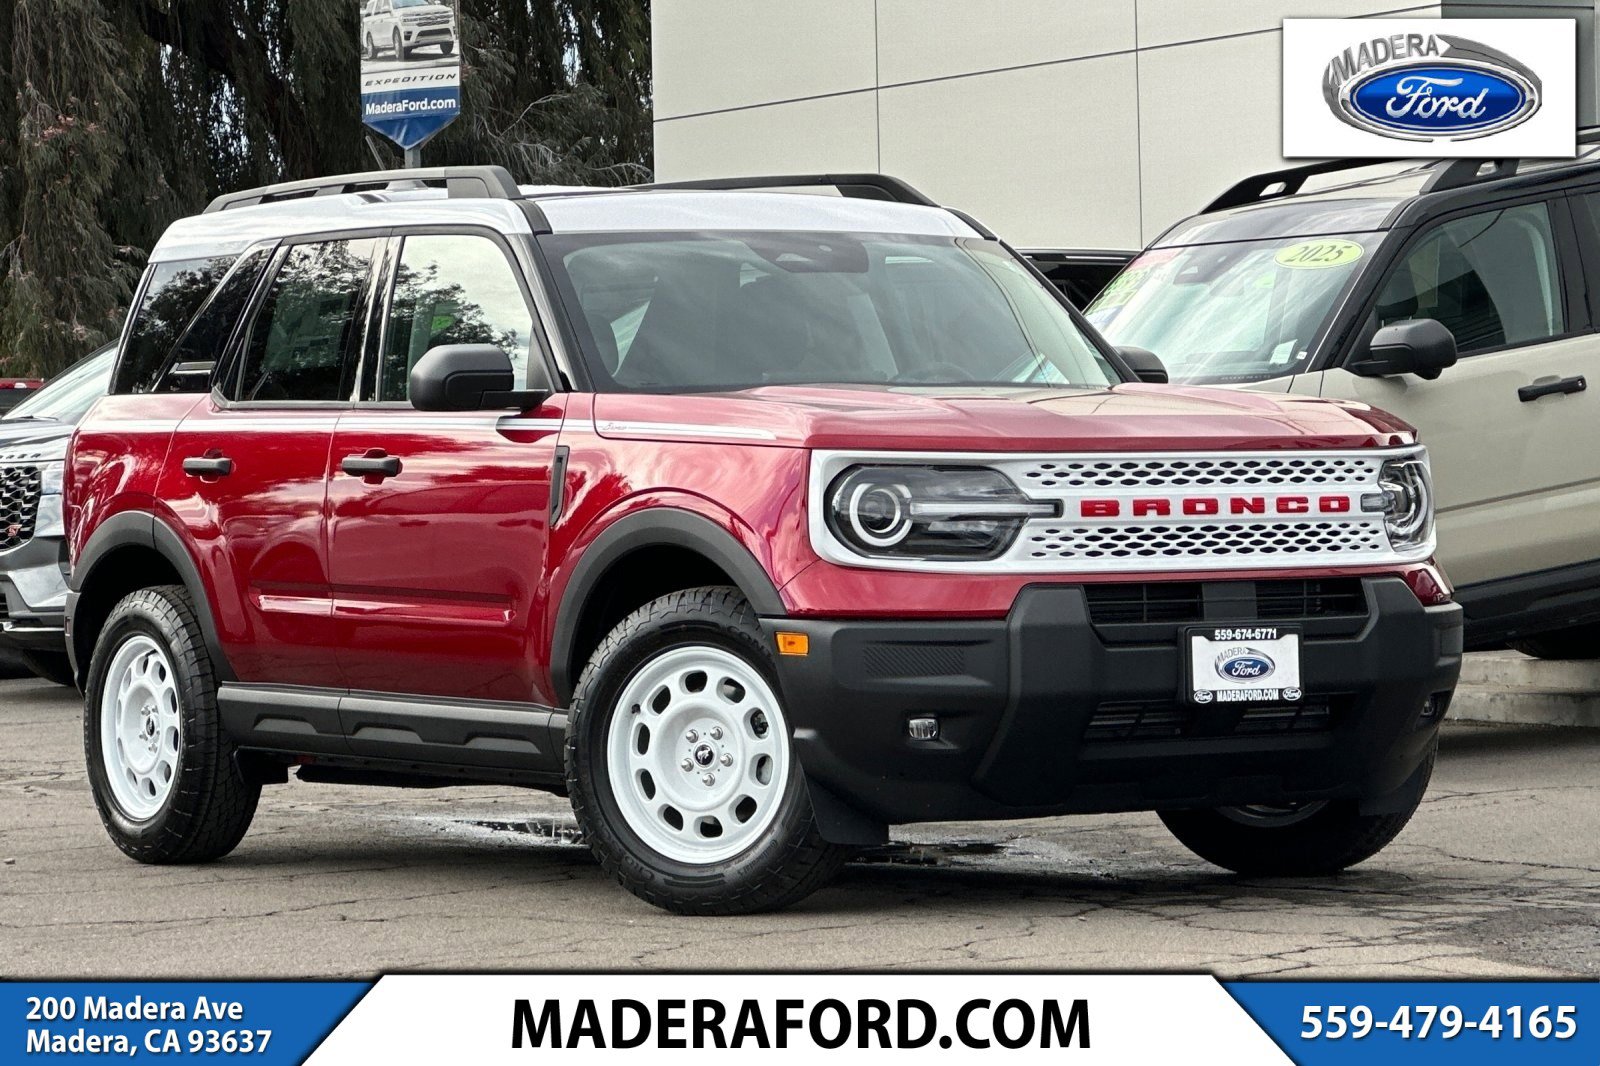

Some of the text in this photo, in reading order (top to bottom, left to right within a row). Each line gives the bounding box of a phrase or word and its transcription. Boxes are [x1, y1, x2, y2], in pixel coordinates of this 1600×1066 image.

[365, 73, 456, 86] EXPEDITION
[365, 98, 456, 116] MaderaFord.com
[1284, 245, 1353, 262] 2025
[1079, 495, 1351, 518] BRONCO
[1214, 628, 1277, 640] 559-674-6771
[1216, 646, 1247, 664] MADERA
[1231, 660, 1261, 676] Ford
[1216, 688, 1280, 702] MADERAFORD.COM
